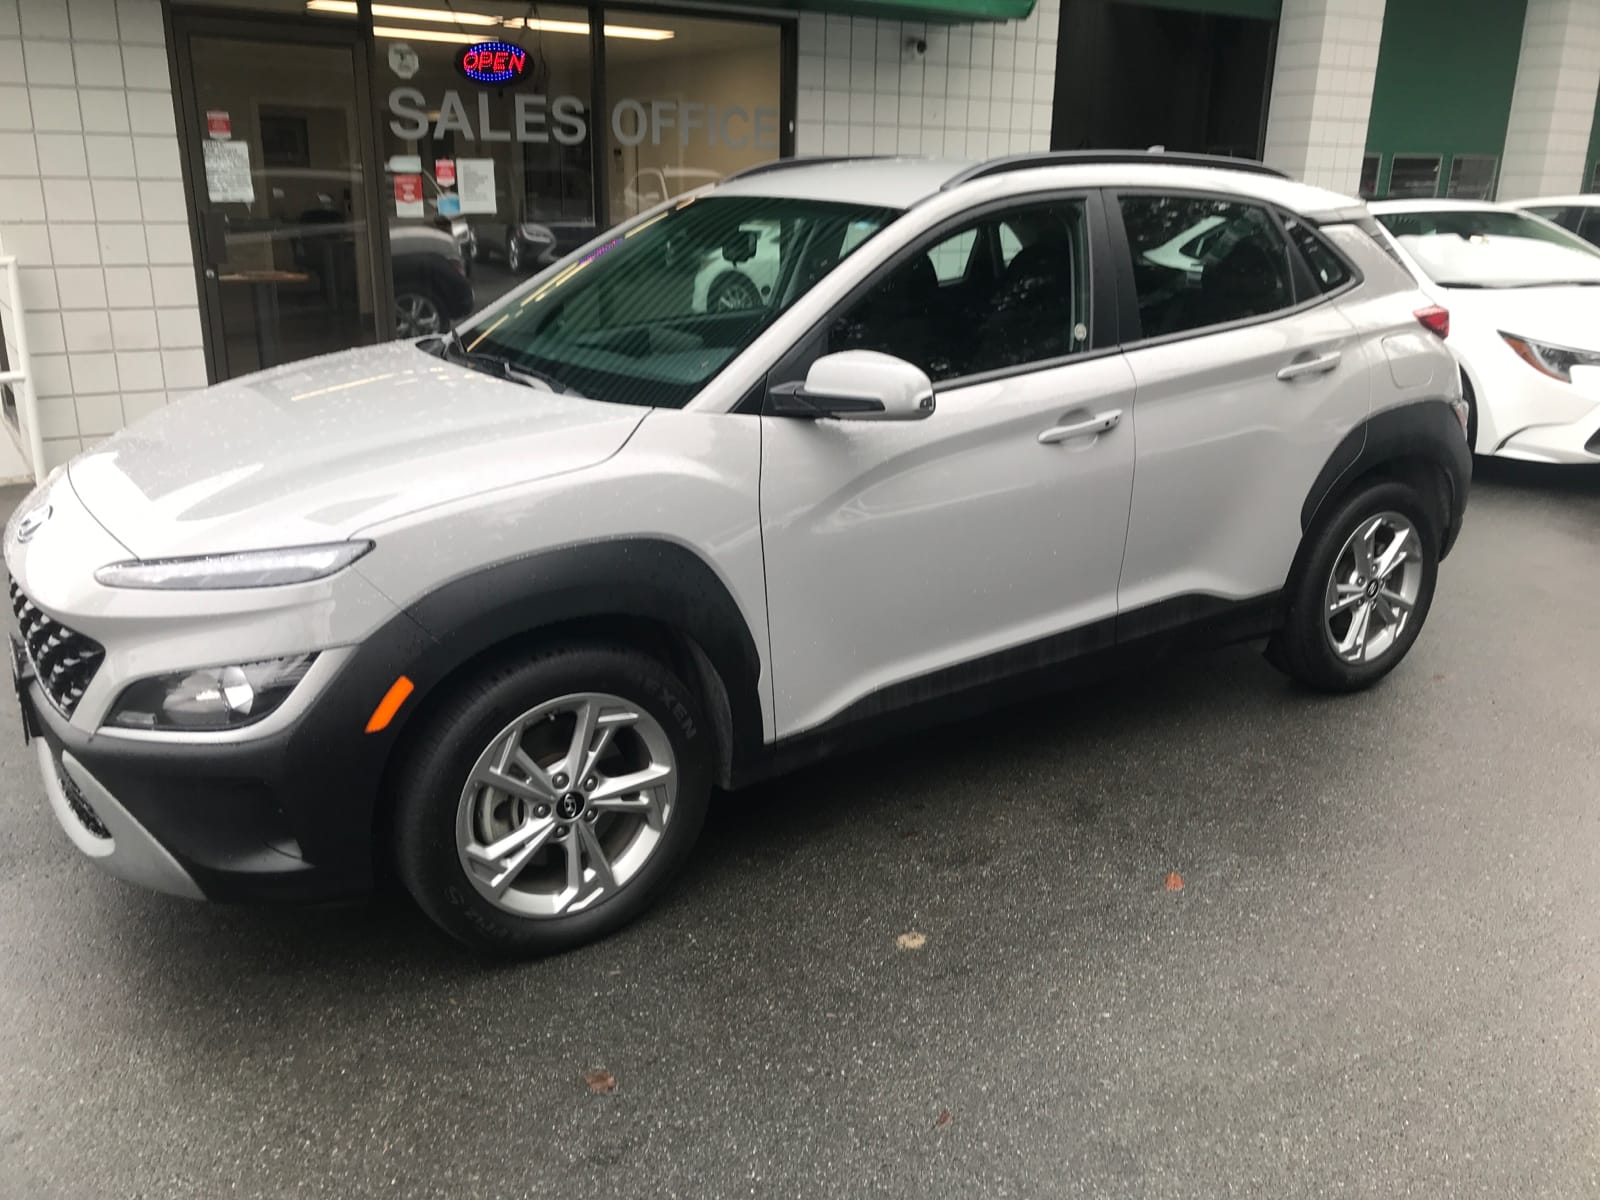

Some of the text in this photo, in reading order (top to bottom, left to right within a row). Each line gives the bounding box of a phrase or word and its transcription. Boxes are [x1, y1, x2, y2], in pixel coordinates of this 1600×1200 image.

[463, 50, 527, 74] OPEN
[388, 87, 777, 150] SALES OFFICE
